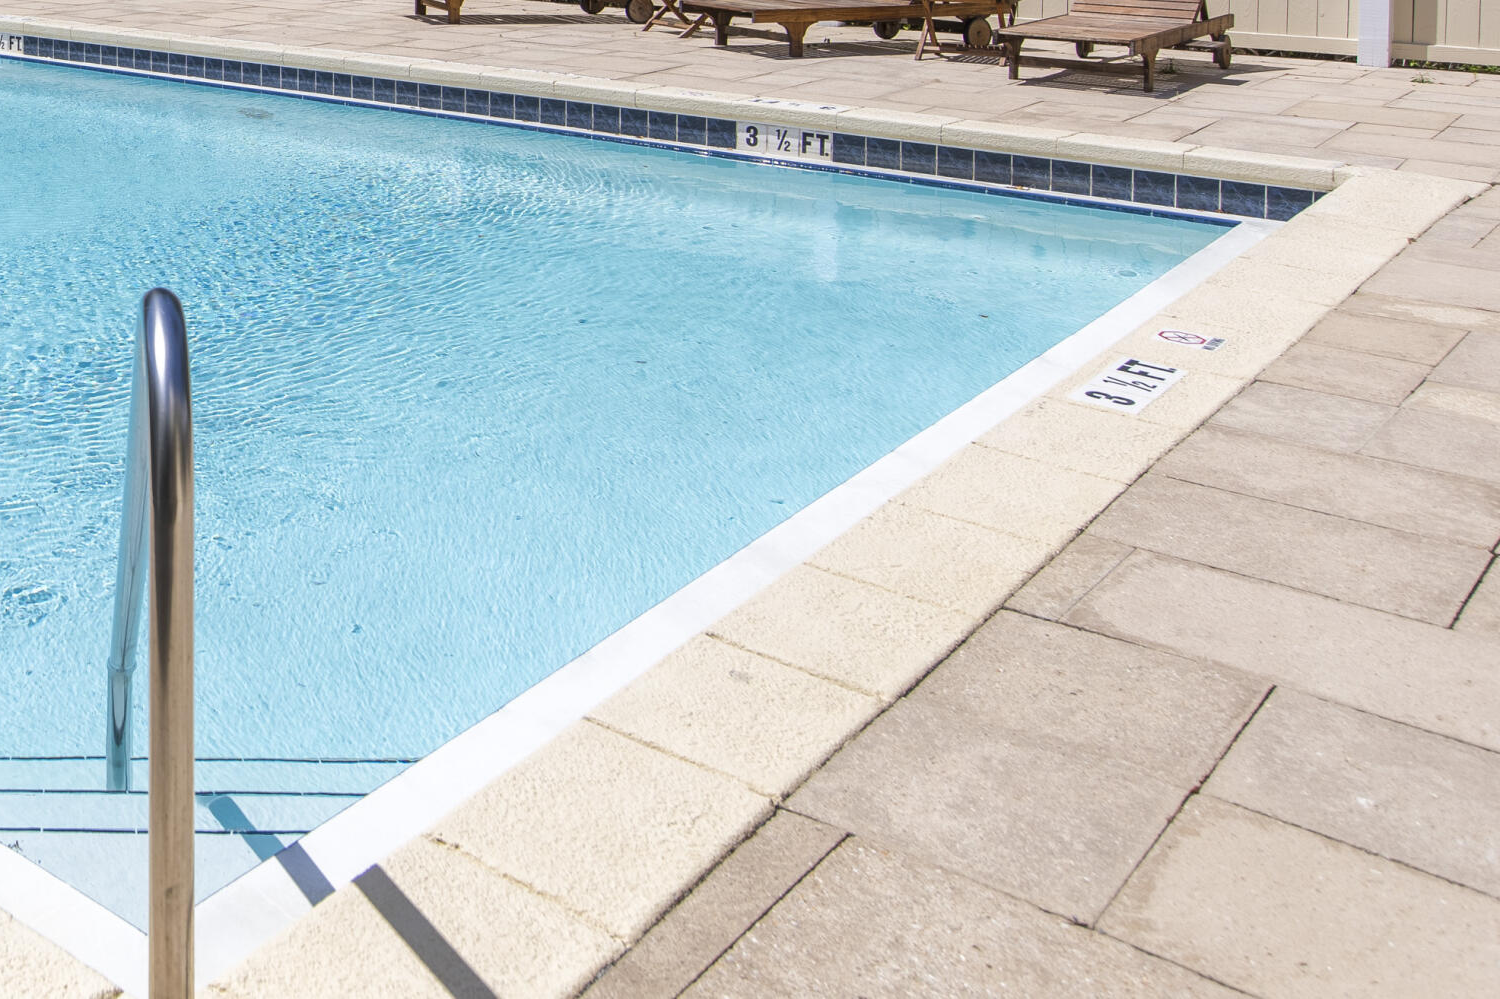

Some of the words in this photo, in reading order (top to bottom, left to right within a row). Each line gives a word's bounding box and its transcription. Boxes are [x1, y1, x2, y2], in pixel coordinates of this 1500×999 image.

[746, 126, 758, 147] 3
[801, 131, 830, 156] FT.
[1085, 390, 1136, 406] 3
